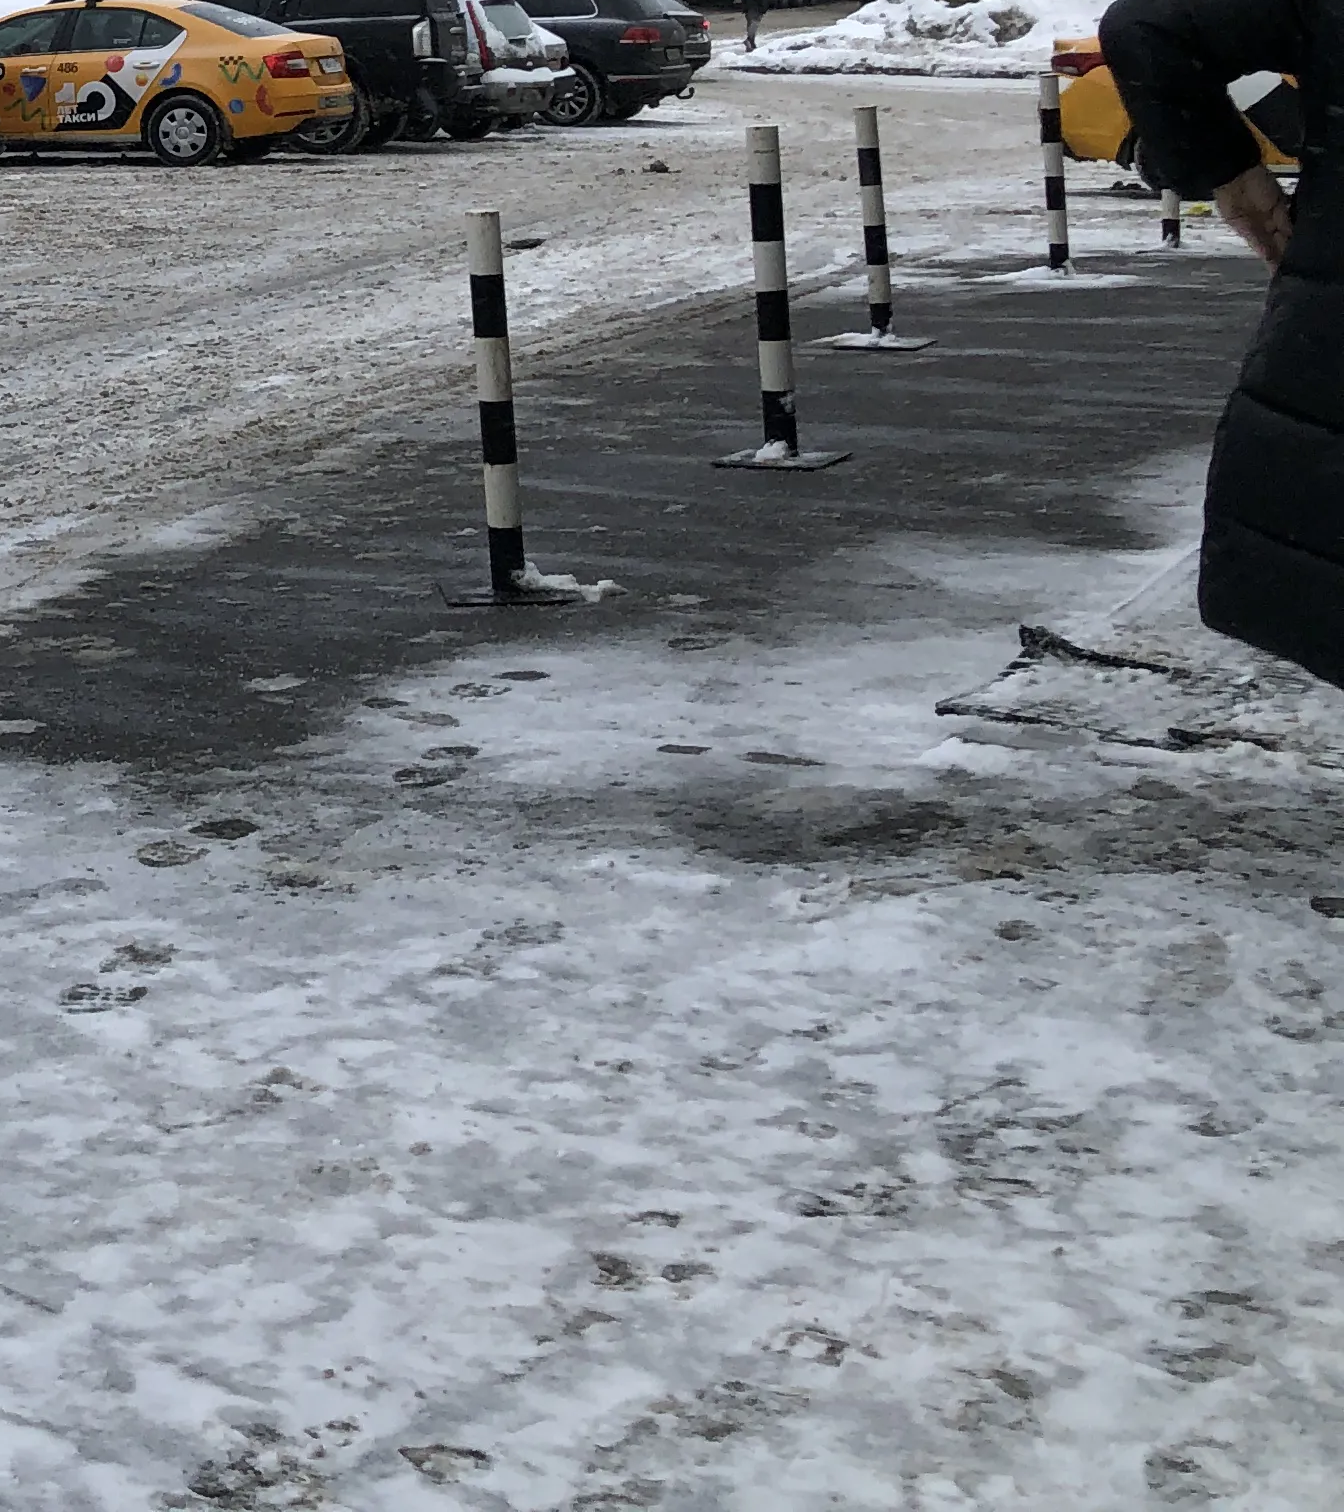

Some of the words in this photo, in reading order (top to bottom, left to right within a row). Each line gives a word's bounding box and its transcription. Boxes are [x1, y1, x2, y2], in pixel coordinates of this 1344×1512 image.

[56, 61, 79, 74] 486
[56, 104, 79, 115] ЛЕТ
[56, 112, 96, 124] ТАКСИ
